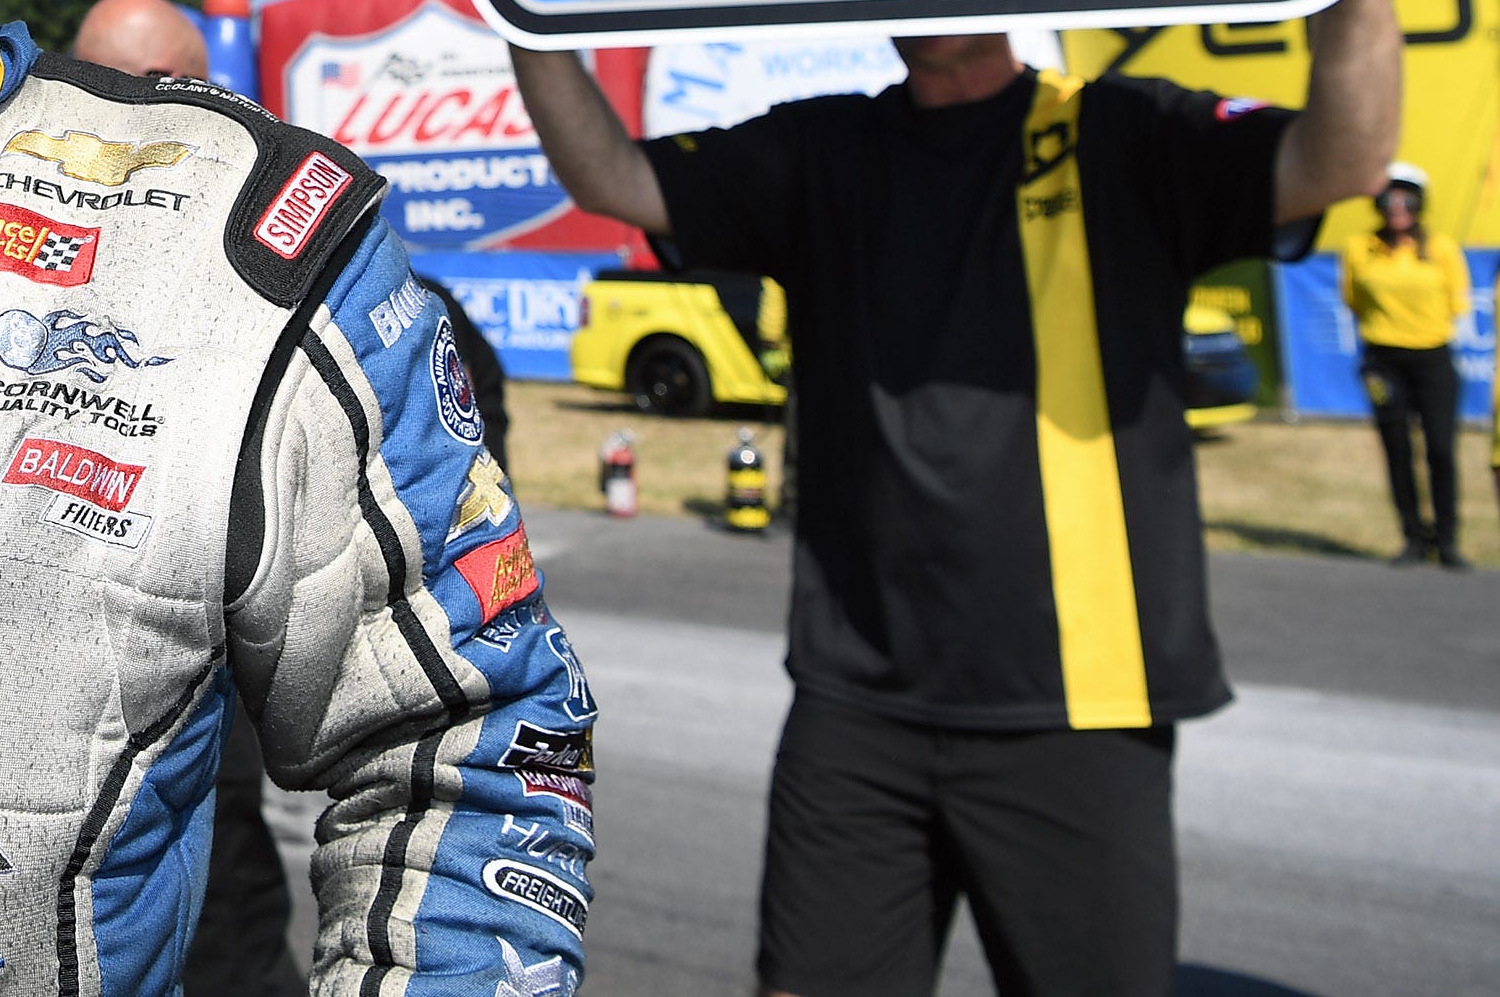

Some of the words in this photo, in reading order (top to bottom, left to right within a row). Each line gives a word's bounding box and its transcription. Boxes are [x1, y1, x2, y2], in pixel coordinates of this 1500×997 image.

[376, 155, 556, 193] PRODUCT
[267, 155, 338, 250] SIMPSON
[404, 197, 485, 233] INC.
[90, 411, 158, 439] TOOLS
[17, 447, 137, 504] BALDWIN
[60, 503, 133, 538] FILTERS
